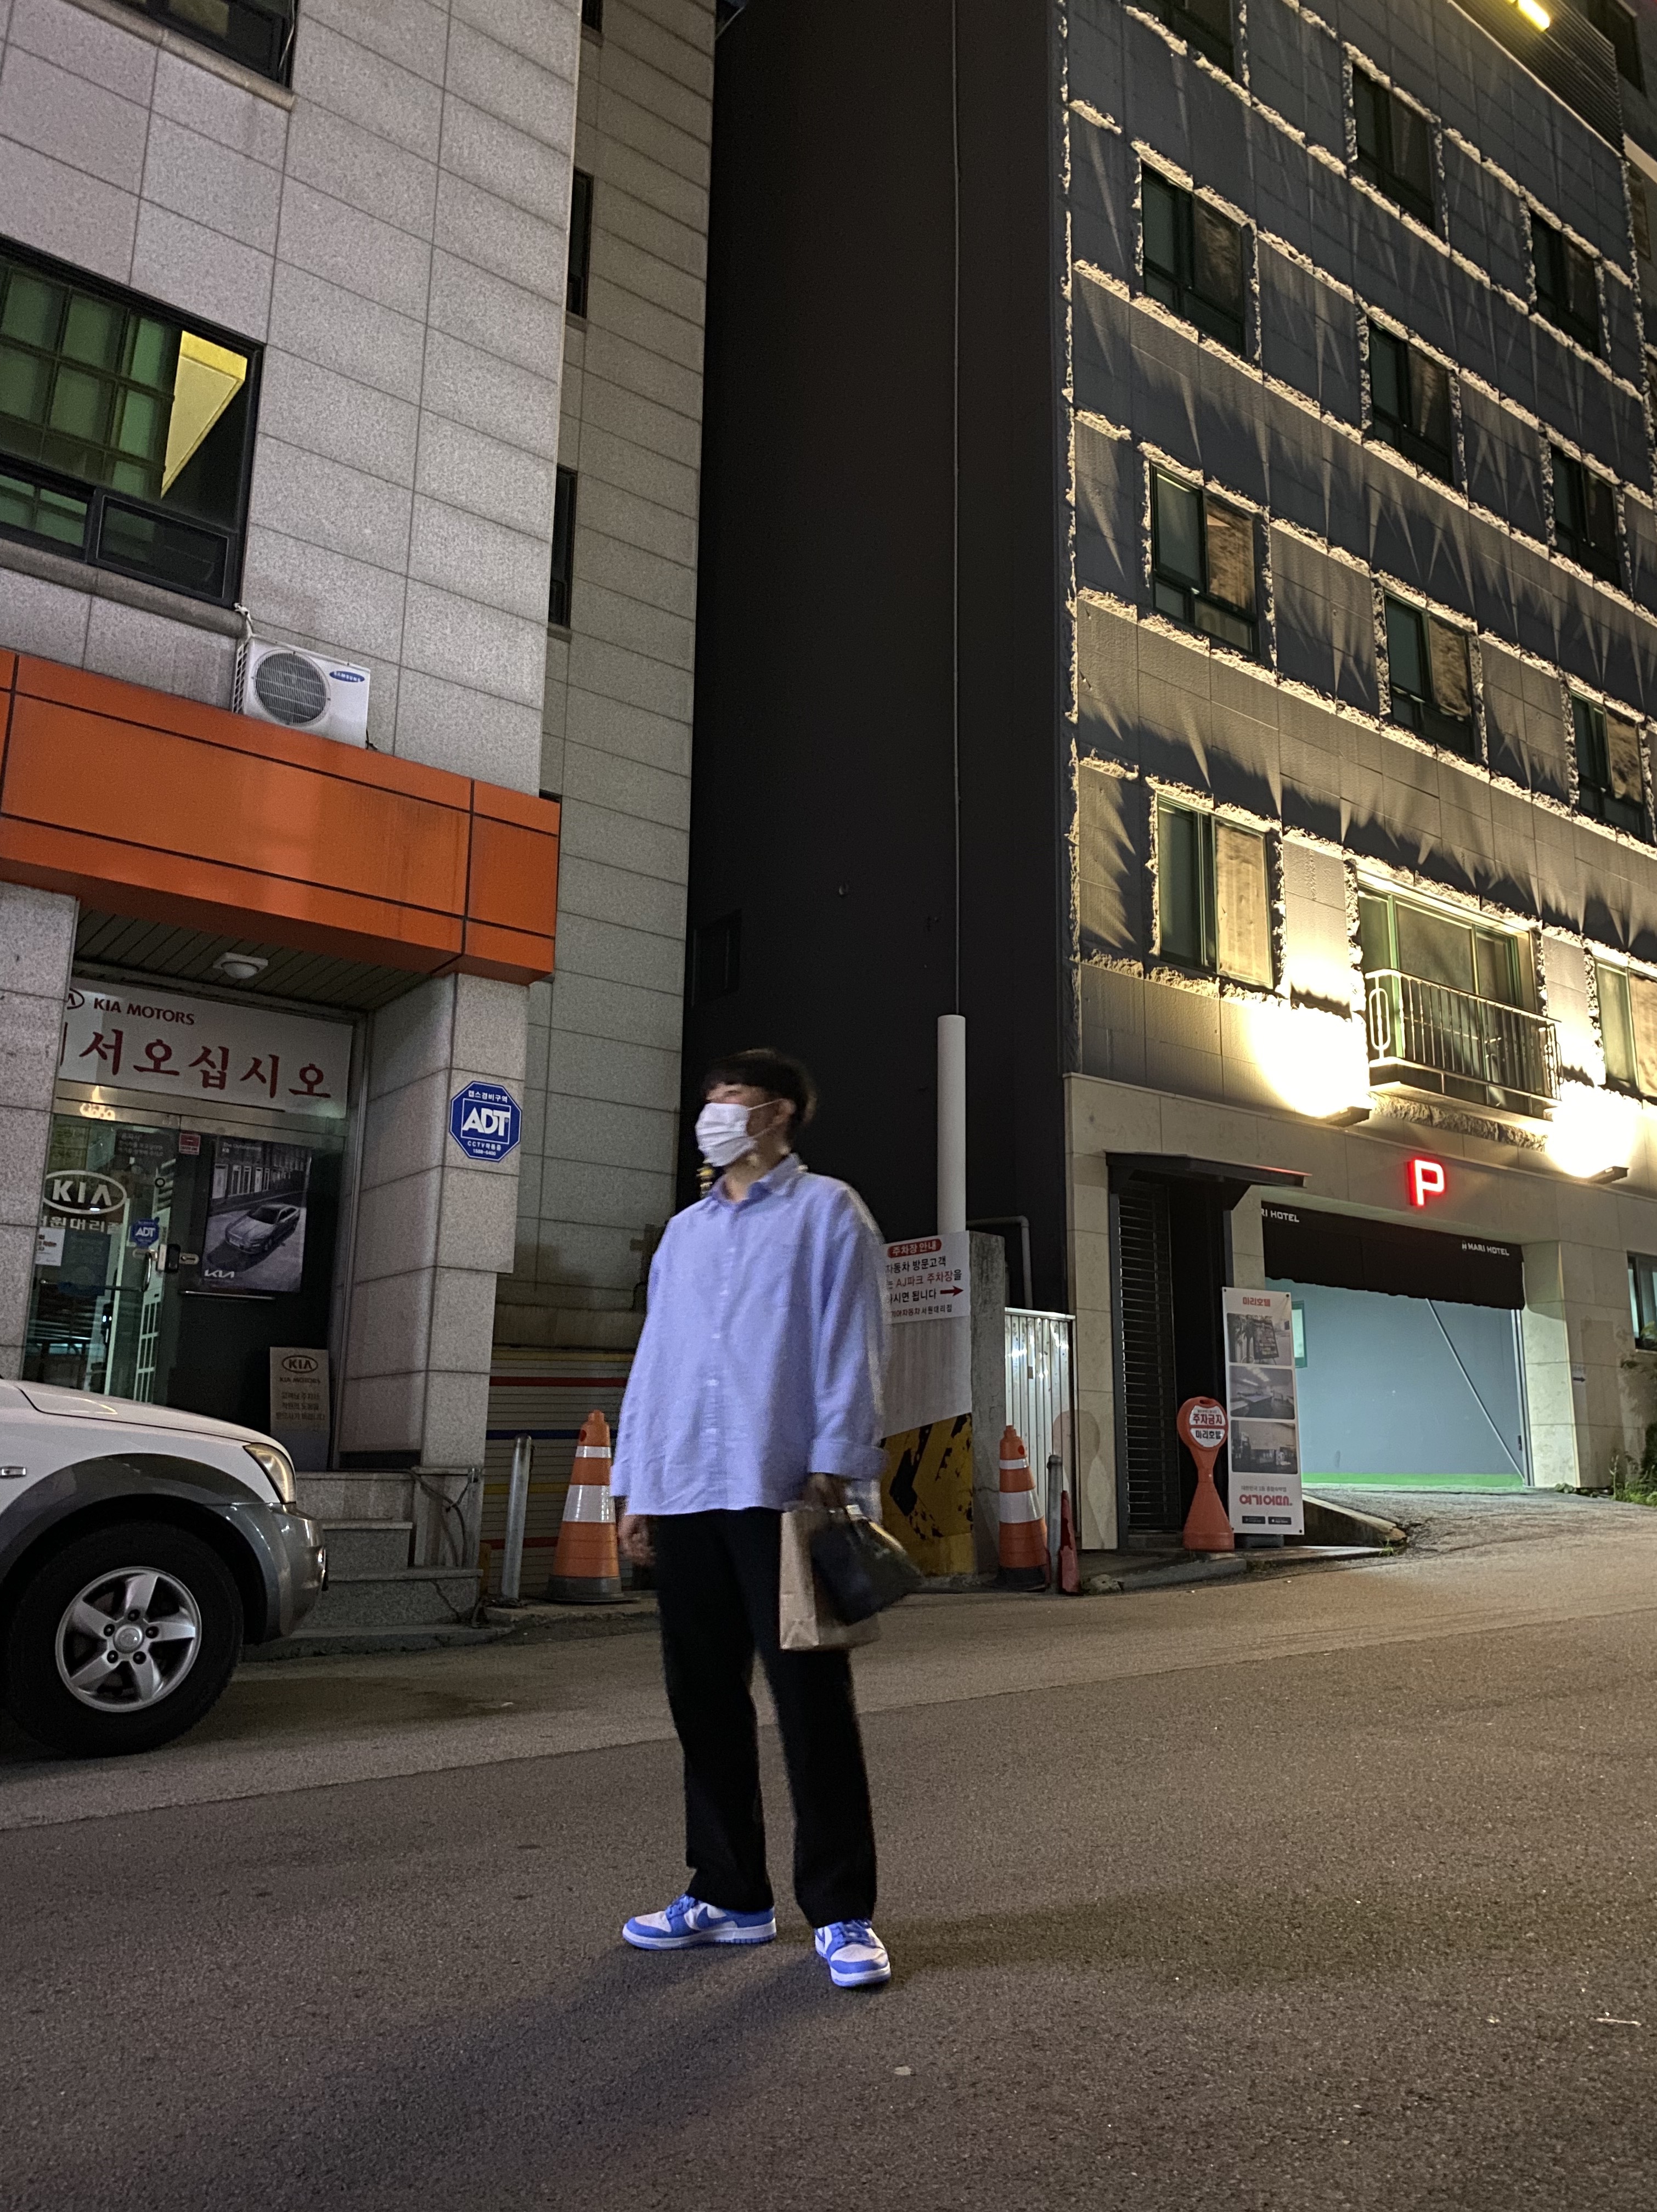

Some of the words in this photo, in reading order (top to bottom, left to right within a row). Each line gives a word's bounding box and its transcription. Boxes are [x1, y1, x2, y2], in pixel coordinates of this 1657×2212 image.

[333, 670, 361, 682] SAMSUNG
[94, 997, 121, 1013] KIA
[127, 1003, 195, 1025] MOTORS
[60, 1022, 331, 1098] 서오십시오
[461, 1107, 510, 1137] ADT
[1410, 1158, 1445, 1206] P
[52, 1179, 112, 1206] KIA
[1270, 1210, 1300, 1223] HOTEL
[135, 1227, 156, 1238] ADT
[892, 1243, 917, 1256] 주차장
[919, 1240, 937, 1253] 안내
[1467, 1242, 1486, 1252] MARI
[1486, 1245, 1510, 1256] HOTEL
[912, 1255, 946, 1271] 방문고객
[896, 1276, 923, 1288] AJ파크
[926, 1269, 962, 1284] 주차장을
[912, 1288, 937, 1302] 됩니다
[1242, 1296, 1271, 1307] 마리호텔
[288, 1359, 313, 1369] KIA
[1193, 1413, 1222, 1425] 주차금지
[1195, 1430, 1222, 1440] 마리호텔
